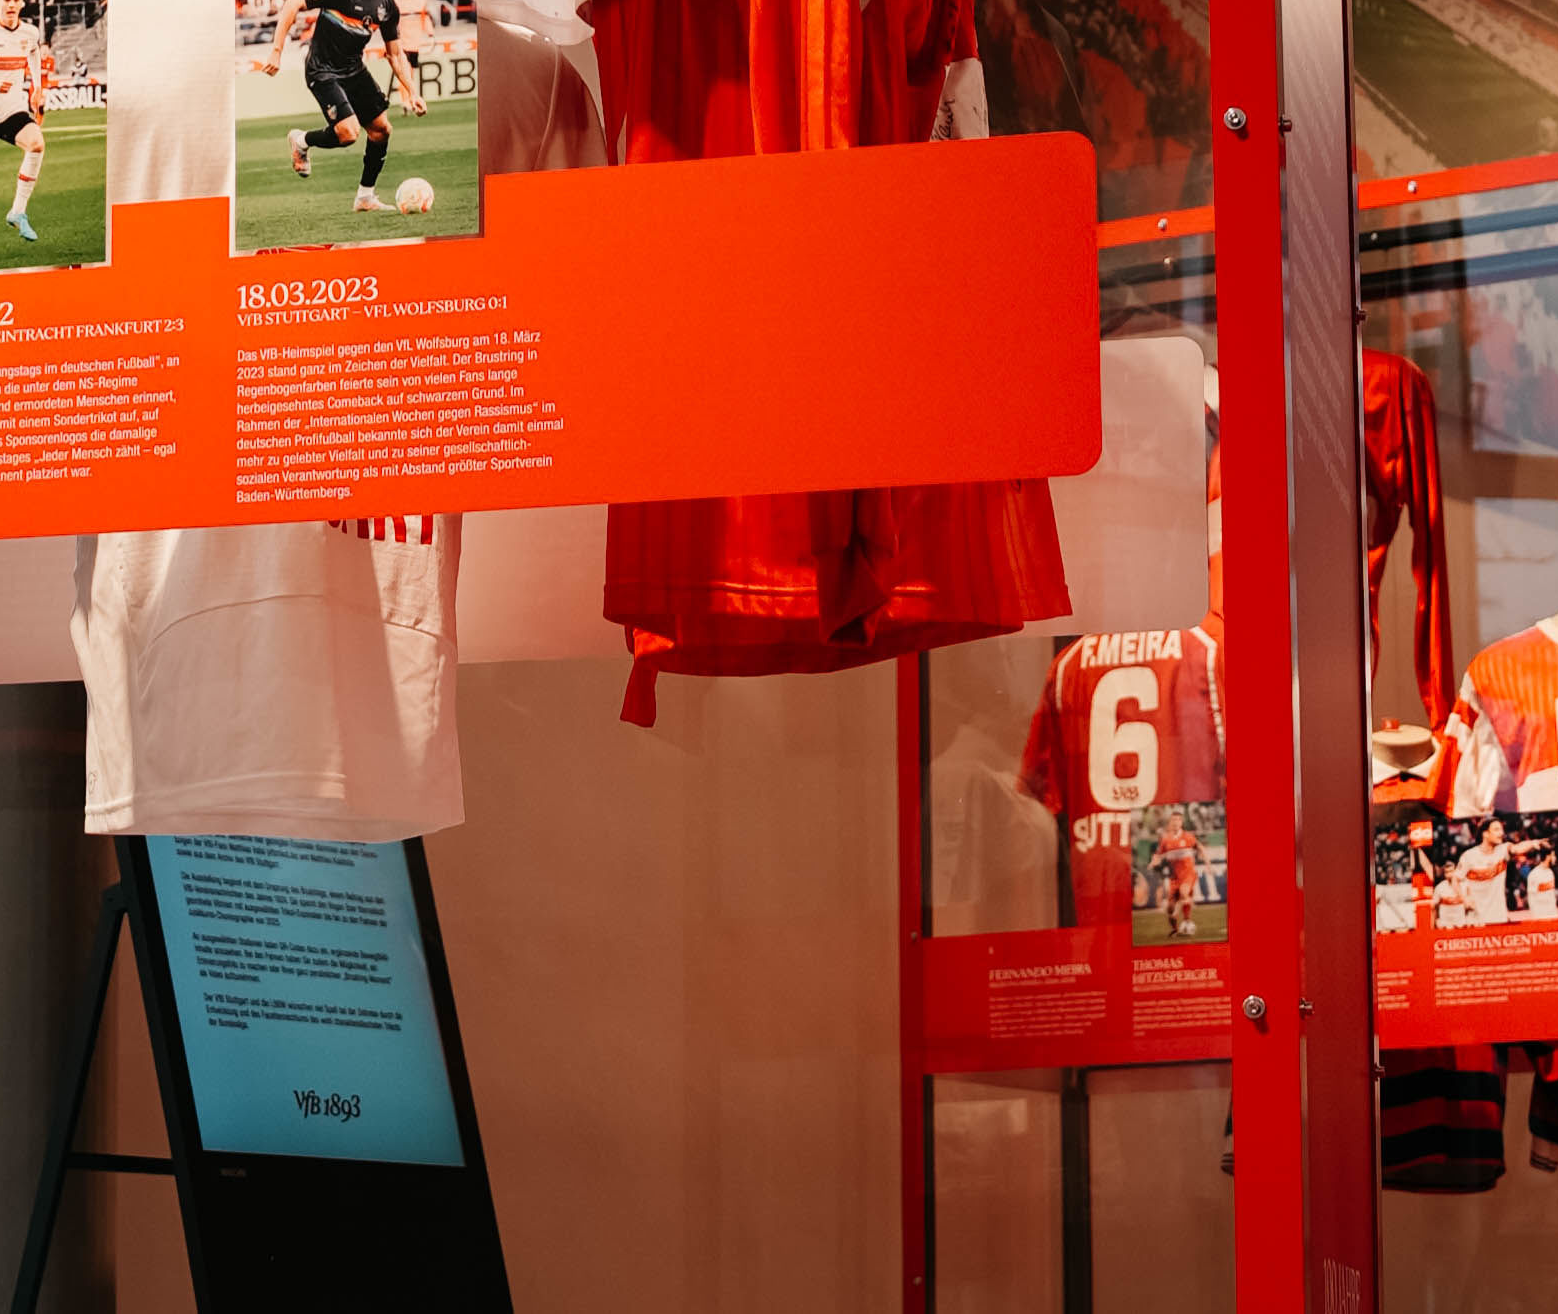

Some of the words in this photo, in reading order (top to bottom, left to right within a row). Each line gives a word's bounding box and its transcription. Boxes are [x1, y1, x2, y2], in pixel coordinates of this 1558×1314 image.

[237, 275, 379, 310] 18.03.2023
[237, 313, 263, 327] VfB
[265, 306, 350, 326] STUTTGART
[392, 296, 486, 317] WOLFSBURG
[488, 294, 508, 310] 0:1
[76, 319, 163, 338] FRANKFURT
[164, 317, 185, 332] 2:3
[236, 349, 258, 362] Das
[259, 343, 335, 360] VfB-Heimspiel
[337, 343, 371, 358] gegen
[372, 341, 393, 353] den
[395, 338, 413, 351] VfL
[415, 336, 470, 350] Wolfsburg
[471, 335, 491, 346] am
[493, 332, 510, 345] 18.
[513, 330, 541, 343] März
[43, 363, 58, 374] im
[59, 359, 115, 374] deutschen
[116, 355, 164, 370] Fußball“,
[165, 356, 179, 367] an
[236, 365, 265, 380] 2023
[267, 363, 297, 377] stand
[299, 364, 325, 378] ganz
[327, 361, 342, 374] im
[344, 358, 387, 373] Zeichen
[389, 357, 408, 369] der
[409, 354, 449, 368] Vielfalt.
[452, 352, 472, 366] Der
[474, 349, 524, 364] Brustring
[527, 349, 537, 360] in
[13, 397, 73, 411] ermordeten
[75, 393, 129, 407] Menschen
[132, 389, 176, 404] erinnert,
[236, 399, 325, 415] herbeigesehntes
[326, 394, 384, 409] Comeback
[386, 392, 403, 405] auf
[405, 390, 469, 404] schwarzem
[471, 386, 507, 399] Grund.
[509, 385, 524, 397] Im
[1080, 629, 1183, 670] F.MEIRA
[1088, 666, 1160, 811] 6
[1434, 935, 1503, 952] CHRISTIAN
[293, 1089, 322, 1118] VfB
[324, 1092, 362, 1123] 1893
